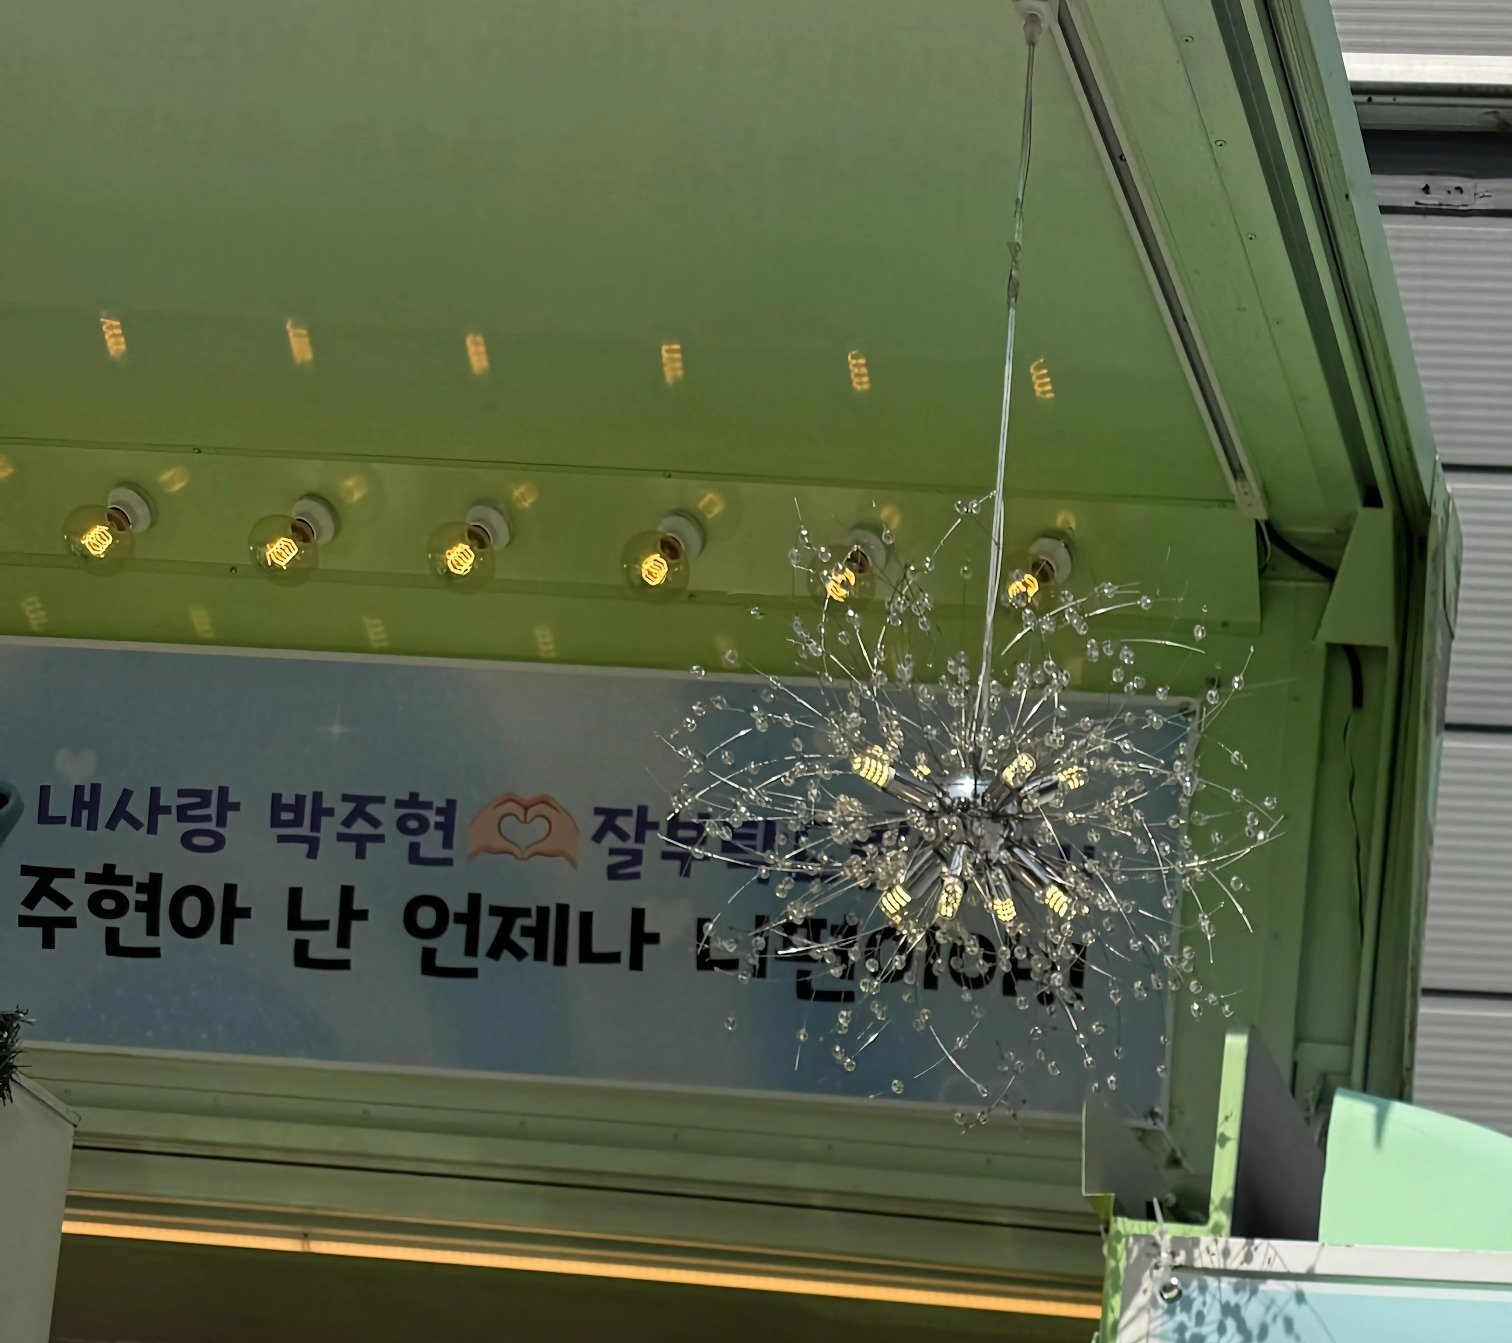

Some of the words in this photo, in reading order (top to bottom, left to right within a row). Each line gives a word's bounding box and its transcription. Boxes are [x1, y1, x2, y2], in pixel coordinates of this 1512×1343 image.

[37, 783, 240, 853] 내사랑
[270, 791, 457, 867] 박주현
[18, 863, 251, 958] 주현아
[287, 885, 368, 970] 난
[403, 893, 660, 978] 언제나
